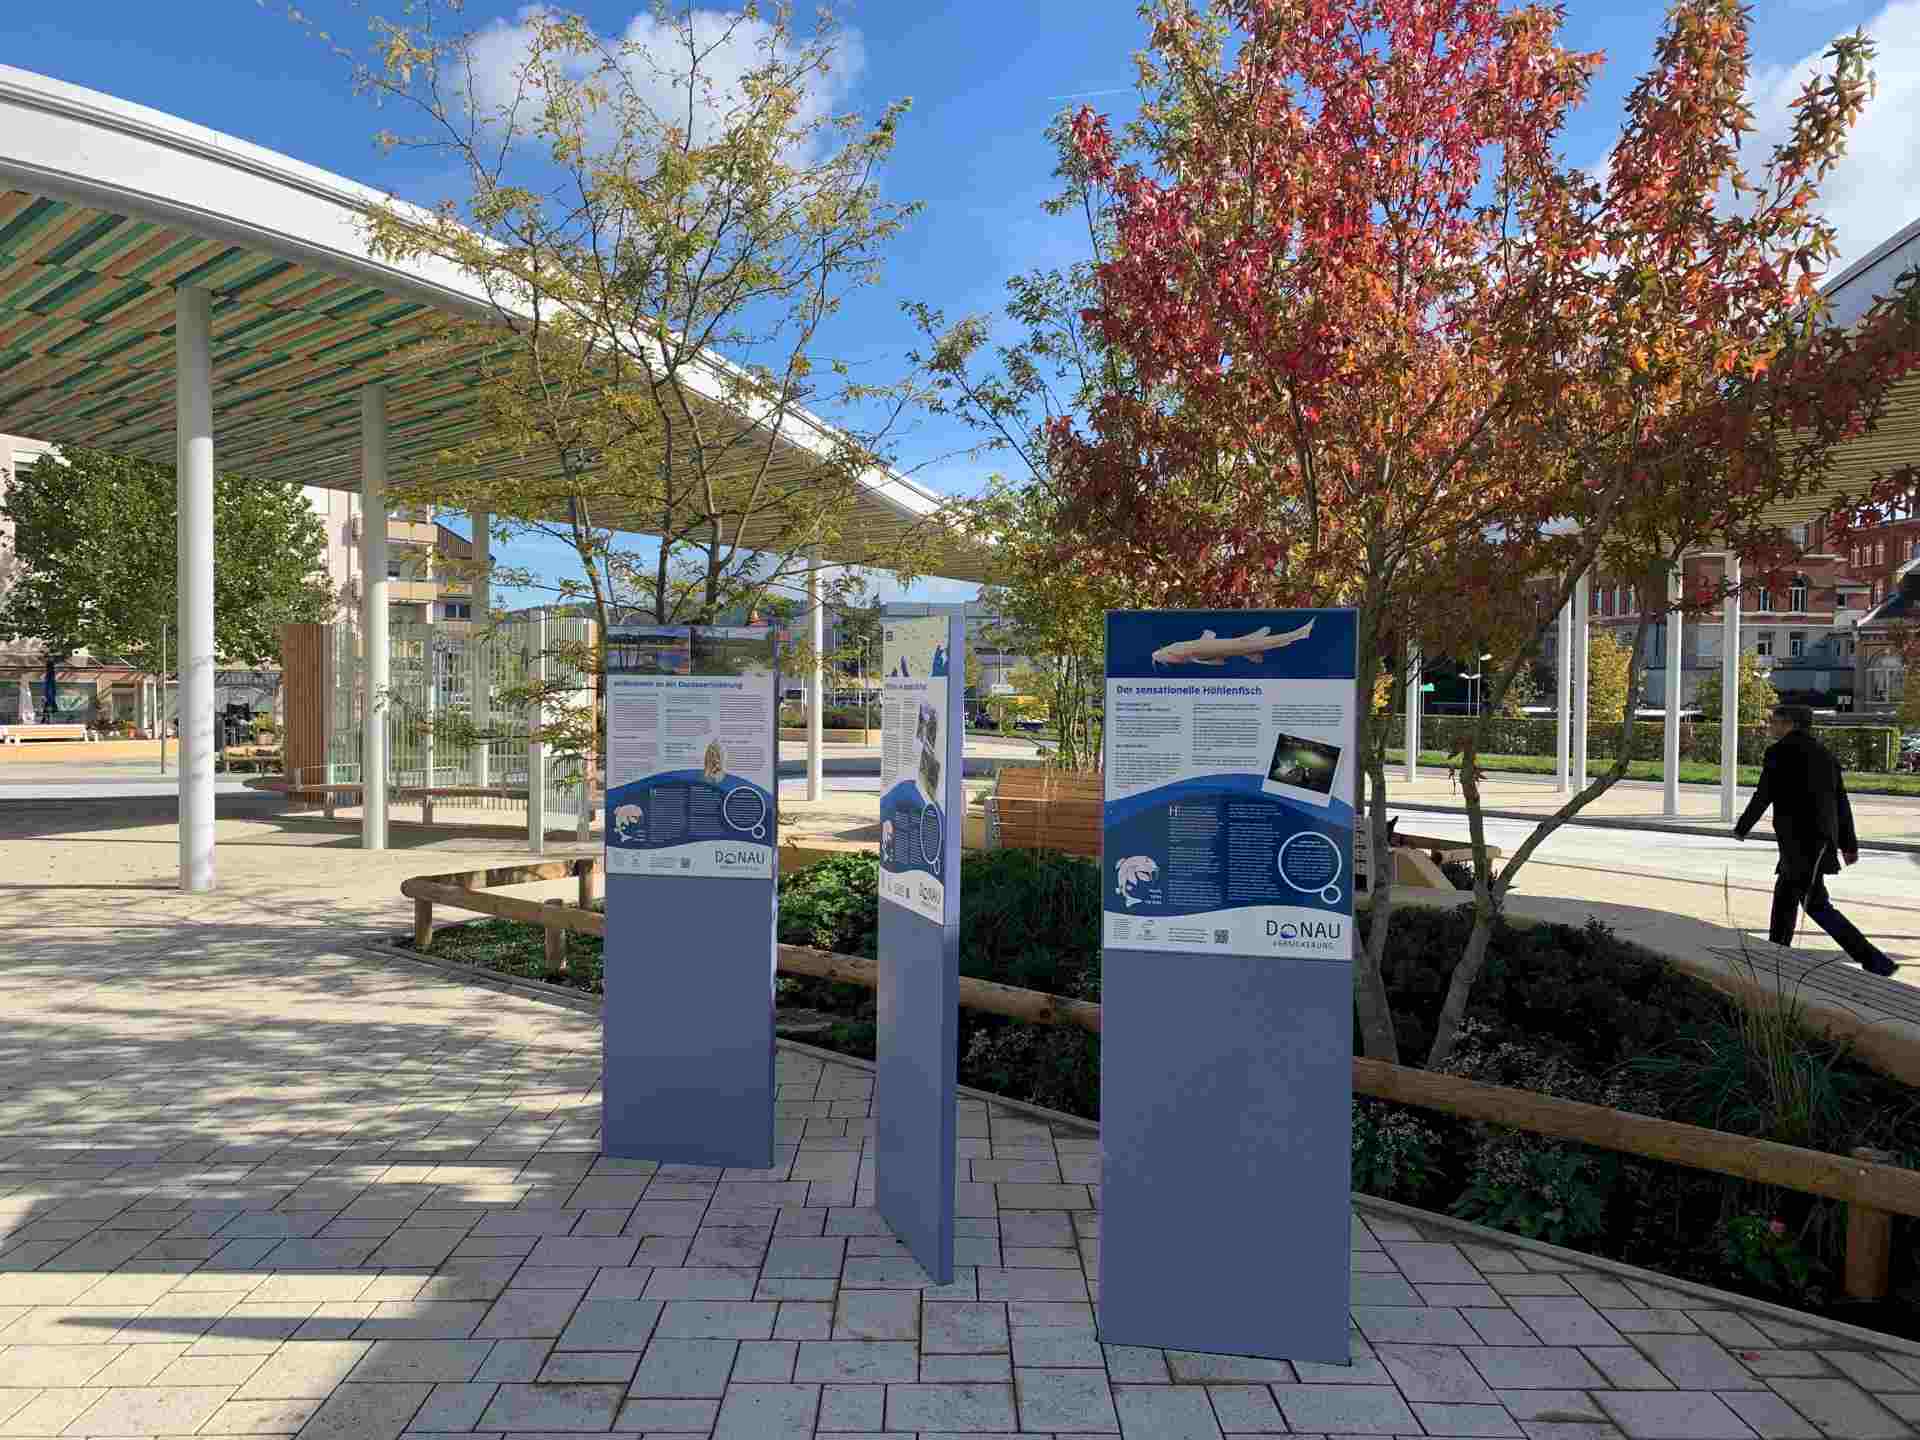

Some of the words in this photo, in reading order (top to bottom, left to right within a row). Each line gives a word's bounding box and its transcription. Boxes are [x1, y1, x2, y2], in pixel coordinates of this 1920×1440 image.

[1116, 684, 1133, 695] Der
[1135, 683, 1201, 696] sensationelle
[1203, 683, 1263, 697] Höhlenfisch
[714, 849, 765, 865] DONAU
[1266, 919, 1341, 939] DONAU
